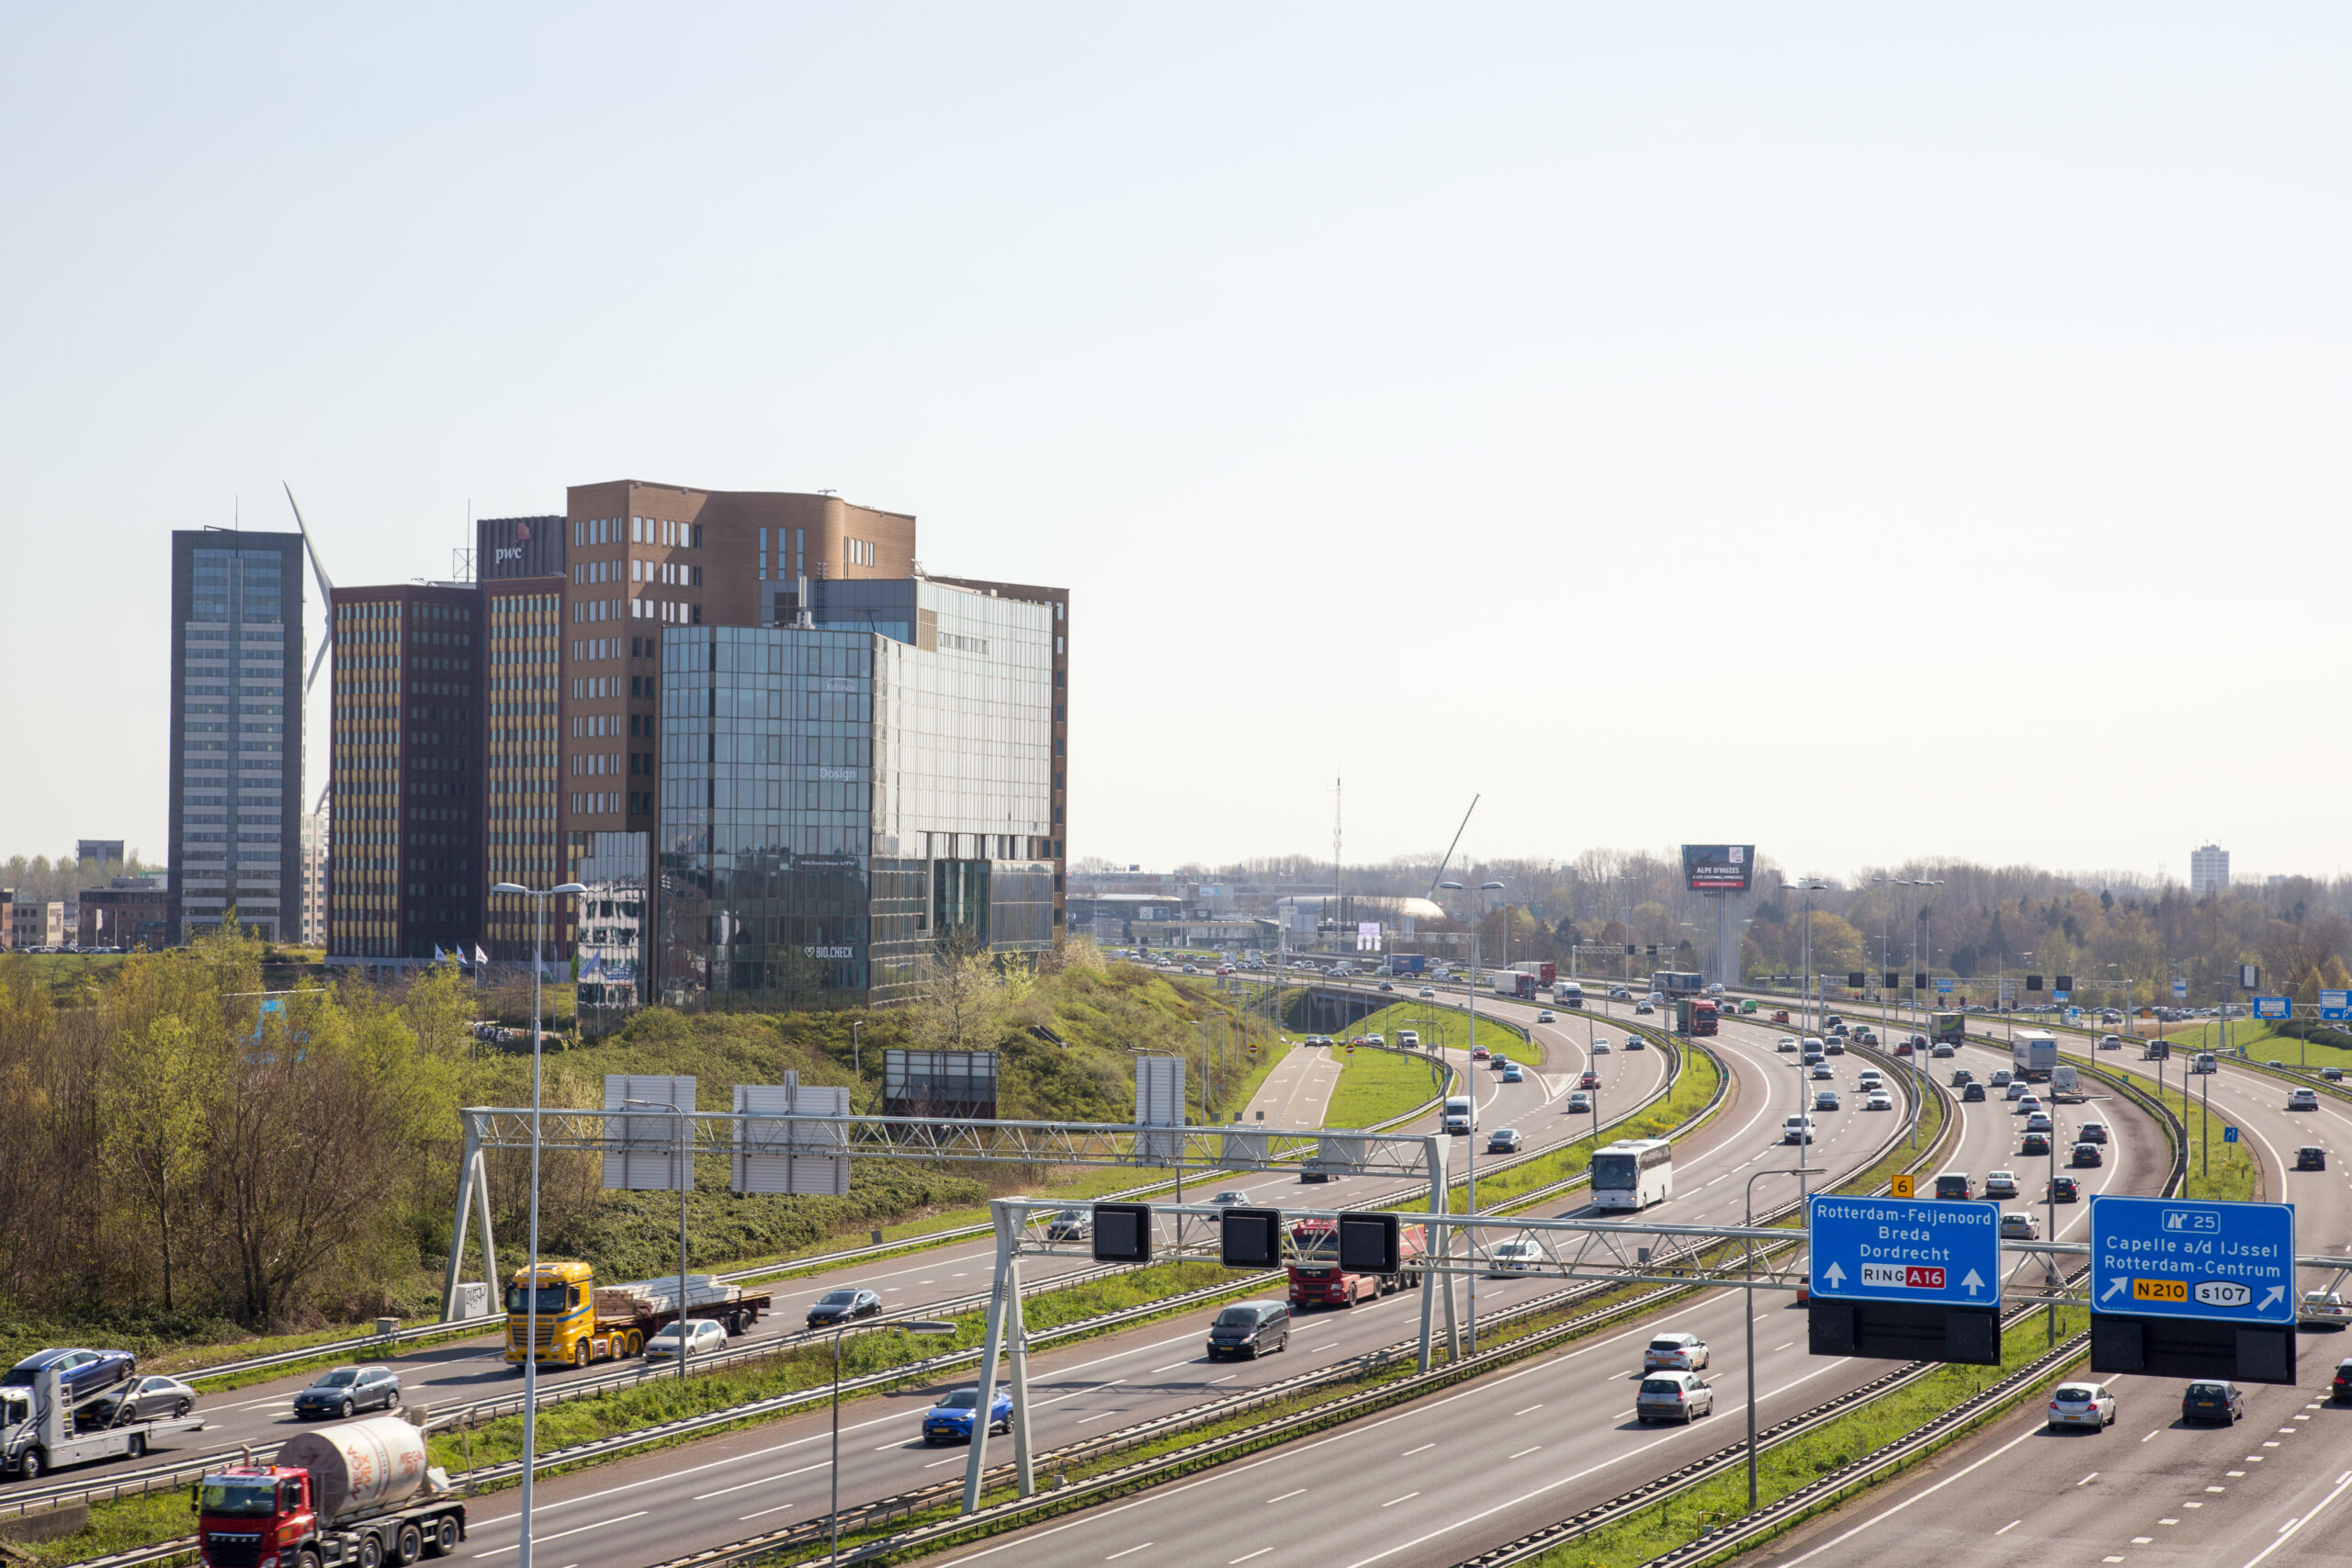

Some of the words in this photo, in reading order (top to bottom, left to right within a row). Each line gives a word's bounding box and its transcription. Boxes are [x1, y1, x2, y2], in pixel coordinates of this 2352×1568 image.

[494, 547, 522, 564] pwc
[820, 768, 856, 781] Dosign
[1897, 1180, 1908, 1193] 6
[1817, 1204, 1991, 1226] Rotterdam-Feijenoord
[2193, 1215, 2215, 1229] 25
[1878, 1226, 1930, 1241] Breda
[1860, 1244, 1951, 1261] Dordrecht
[2107, 1235, 2177, 1252] Capelle
[2184, 1239, 2212, 1255] a/d
[2221, 1241, 2278, 1258] IJssel
[2105, 1255, 2281, 1278] Rotterdam-Centrum
[1863, 1269, 1905, 1282] RING
[1909, 1270, 1943, 1285] A16
[2137, 1282, 2185, 1298] N210
[2201, 1287, 2245, 1302] s107
